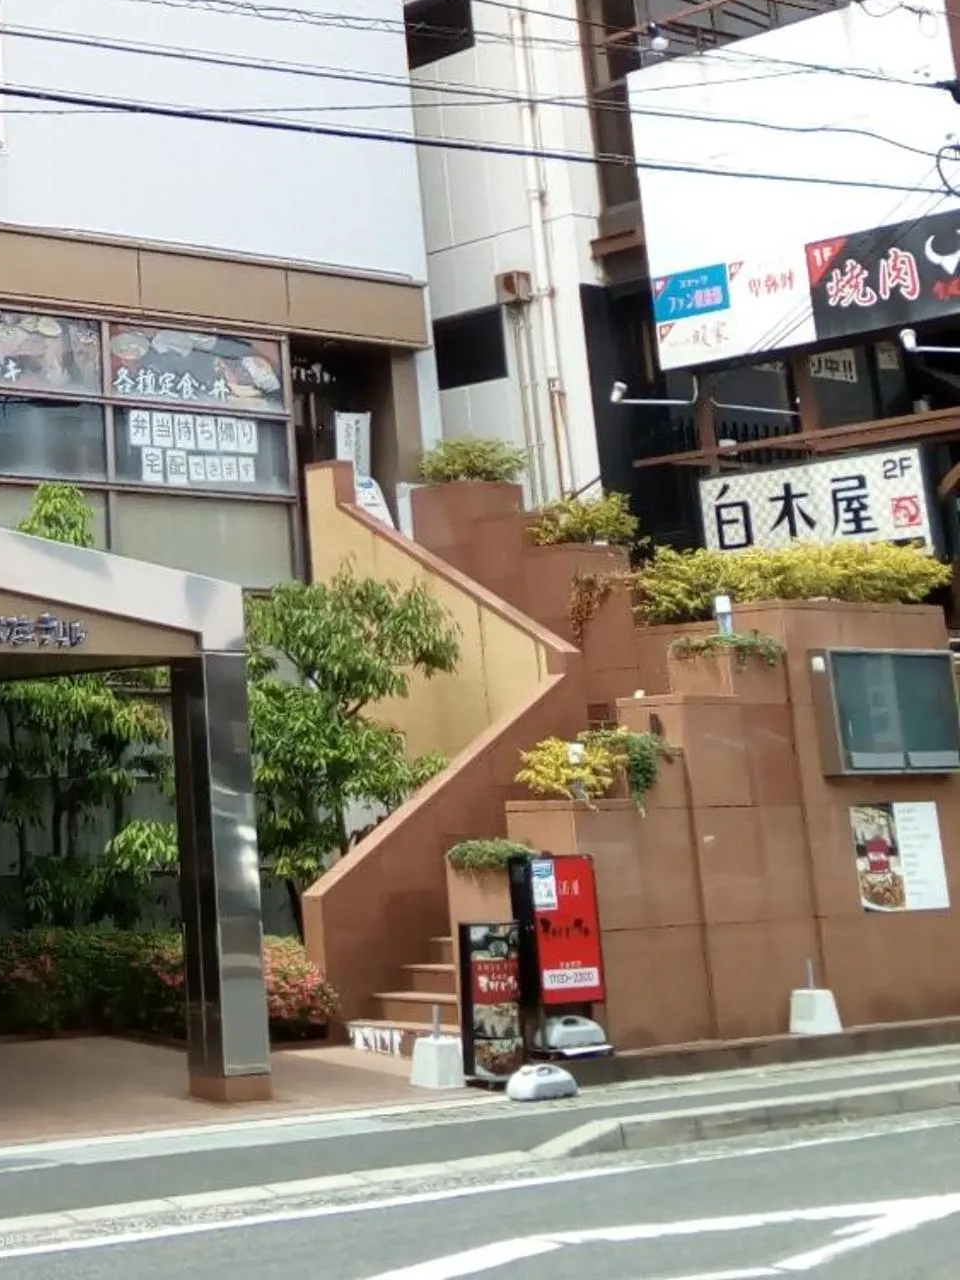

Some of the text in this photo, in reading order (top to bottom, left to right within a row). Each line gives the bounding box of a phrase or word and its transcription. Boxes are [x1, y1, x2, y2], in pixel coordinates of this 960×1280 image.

[813, 247, 833, 267] 1F
[826, 247, 920, 307] 焼肉
[131, 415, 253, 445] 弁当持ち帰り
[145, 452, 253, 477] 宅配できます
[882, 457, 913, 479] 2F
[715, 474, 878, 550] 白木屋
